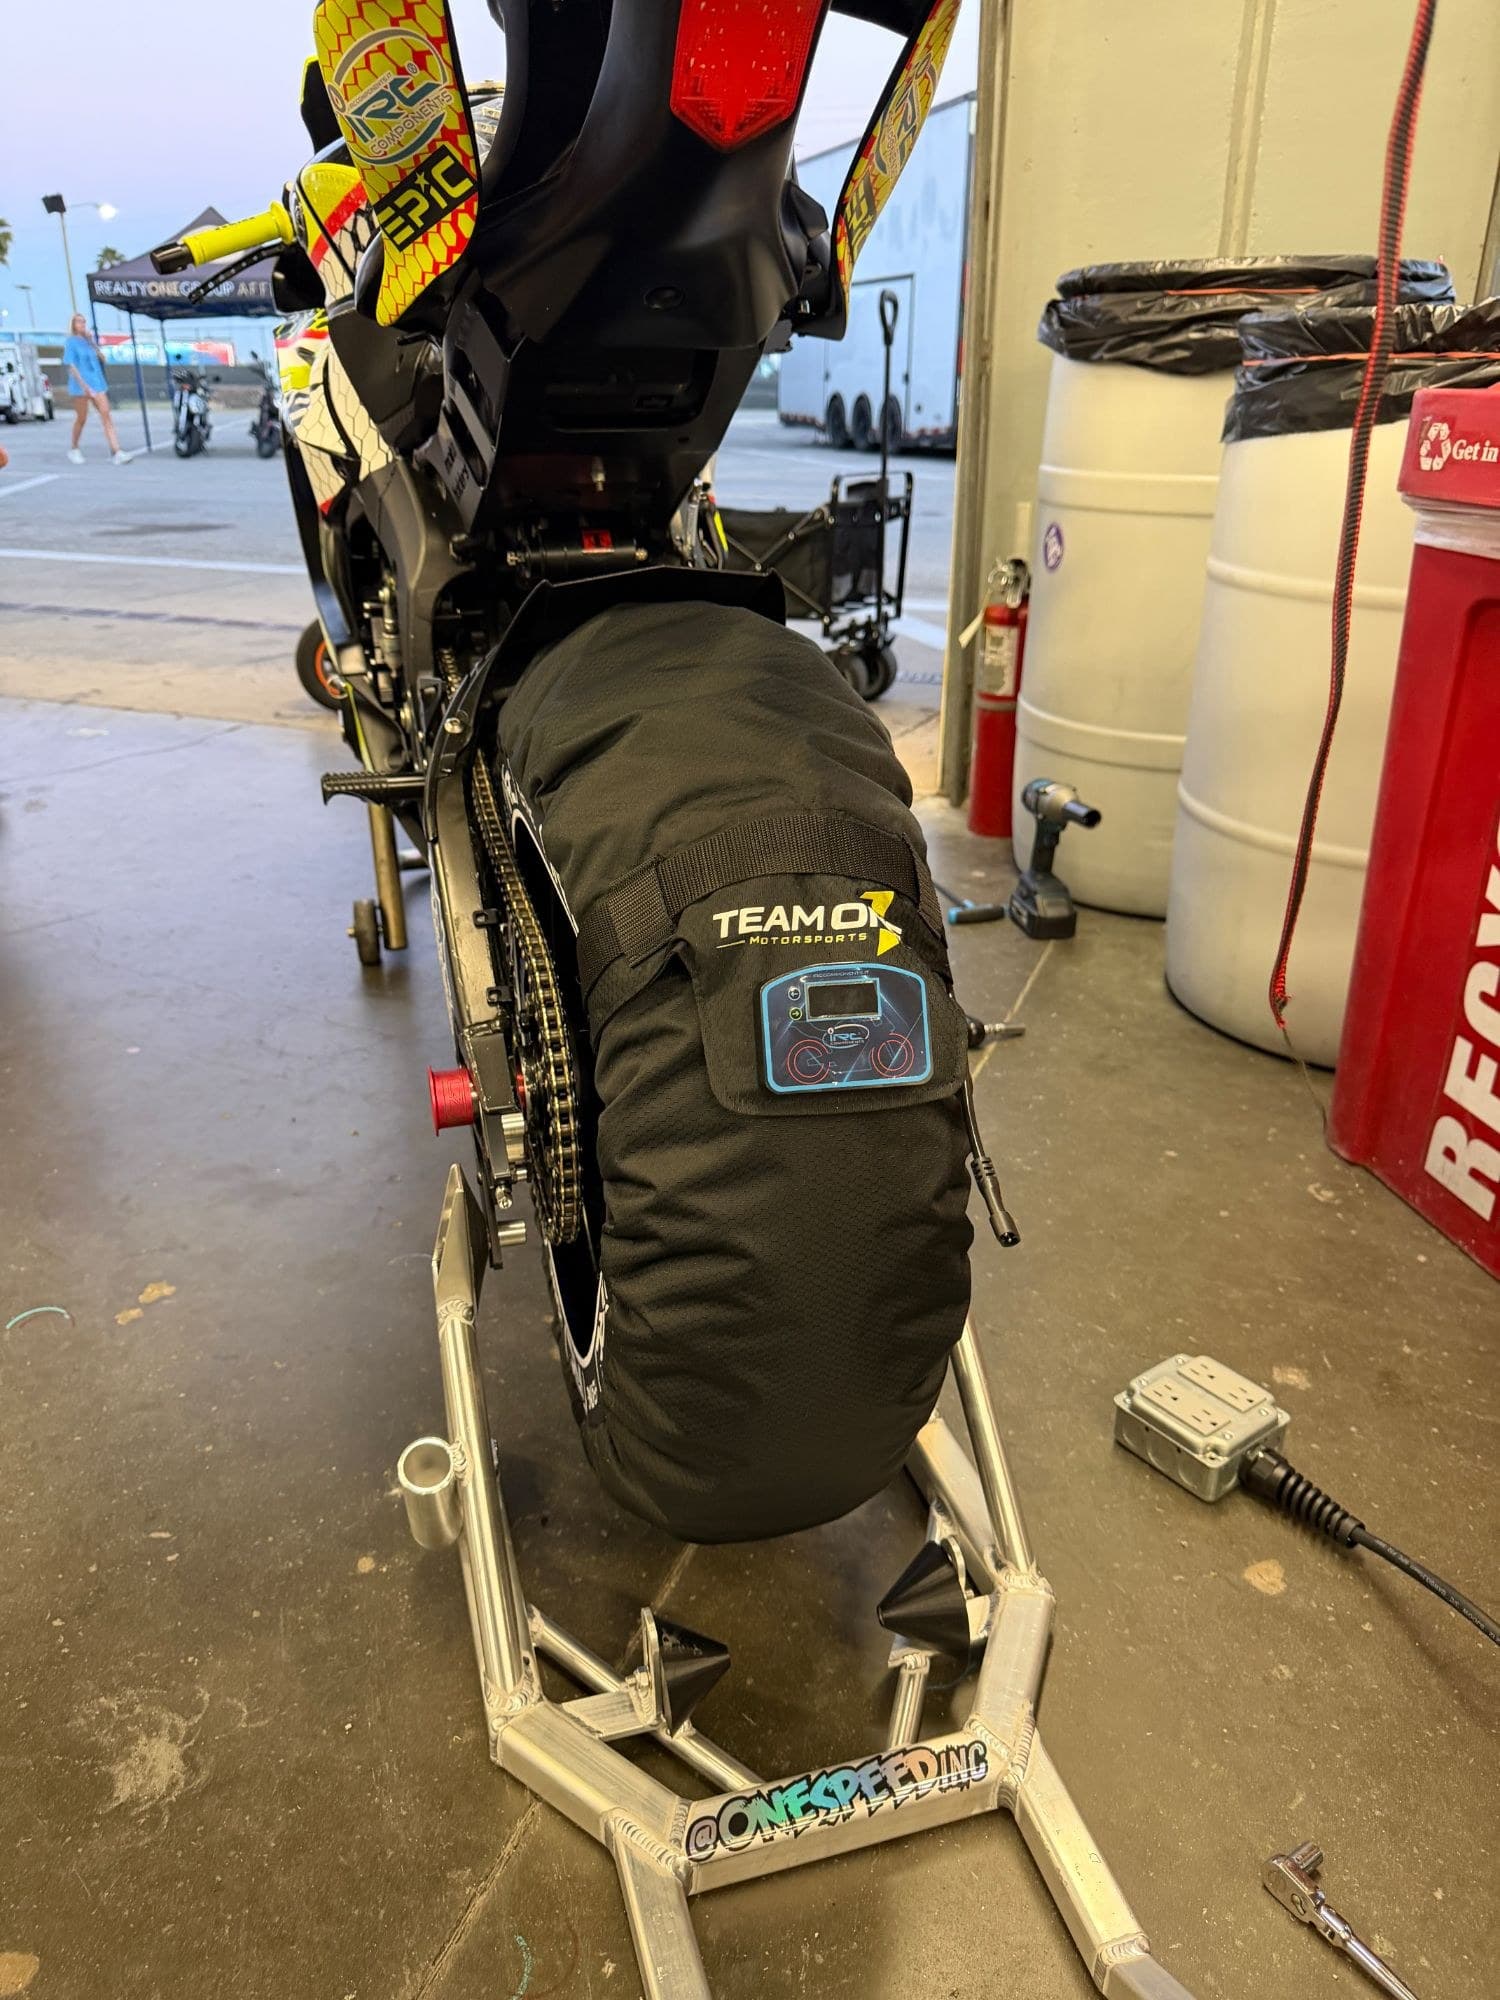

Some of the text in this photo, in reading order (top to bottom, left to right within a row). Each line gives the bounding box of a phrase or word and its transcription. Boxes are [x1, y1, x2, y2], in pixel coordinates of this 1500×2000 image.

[370, 89, 453, 156] COMPONENTS
[379, 155, 474, 245] EPIC
[1452, 439, 1499, 463] Get in
[713, 905, 825, 938] TEAM
